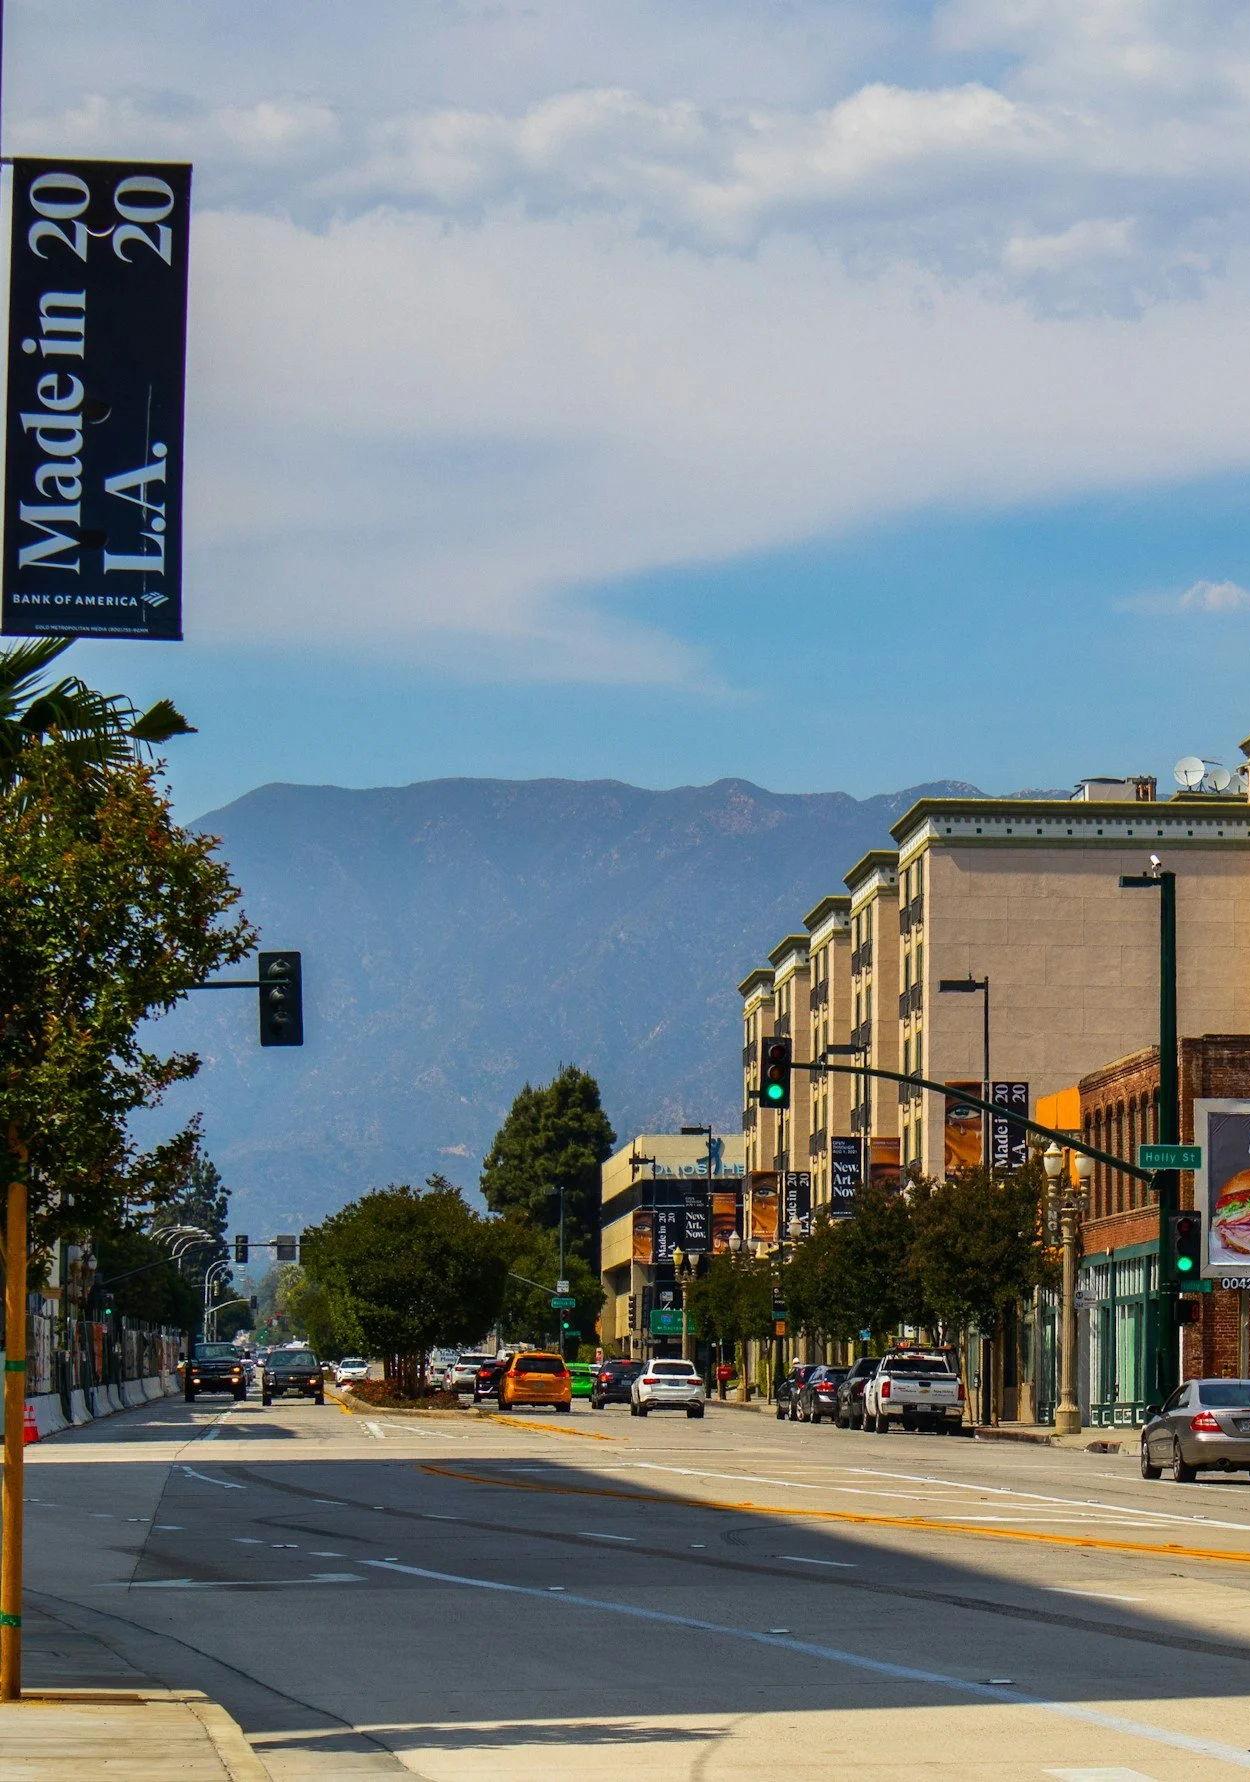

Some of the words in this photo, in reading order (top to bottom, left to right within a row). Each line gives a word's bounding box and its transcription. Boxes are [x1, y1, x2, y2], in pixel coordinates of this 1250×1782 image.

[28, 172, 91, 263] 20
[112, 175, 175, 266] 20
[22, 289, 87, 360] in
[18, 372, 86, 575] Made
[103, 441, 168, 576] L.A.
[12, 593, 50, 605] BANK
[54, 594, 72, 605] OF
[74, 595, 139, 607] AMERICA
[994, 1083, 1009, 1104] 20
[1011, 1083, 1026, 1104] 20
[1145, 1151, 1177, 1164] Holly
[1182, 1152, 1196, 1163] St
[833, 1161, 859, 1173] New.
[787, 1172, 798, 1187] 20
[799, 1172, 809, 1187] 20
[833, 1173, 855, 1185] Art.
[658, 1212, 667, 1223] 20
[667, 1212, 676, 1223] 20
[685, 1211, 706, 1221] New.
[685, 1220, 702, 1229] Art.
[685, 1229, 707, 1239] Now.
[658, 1234, 667, 1258] Made
